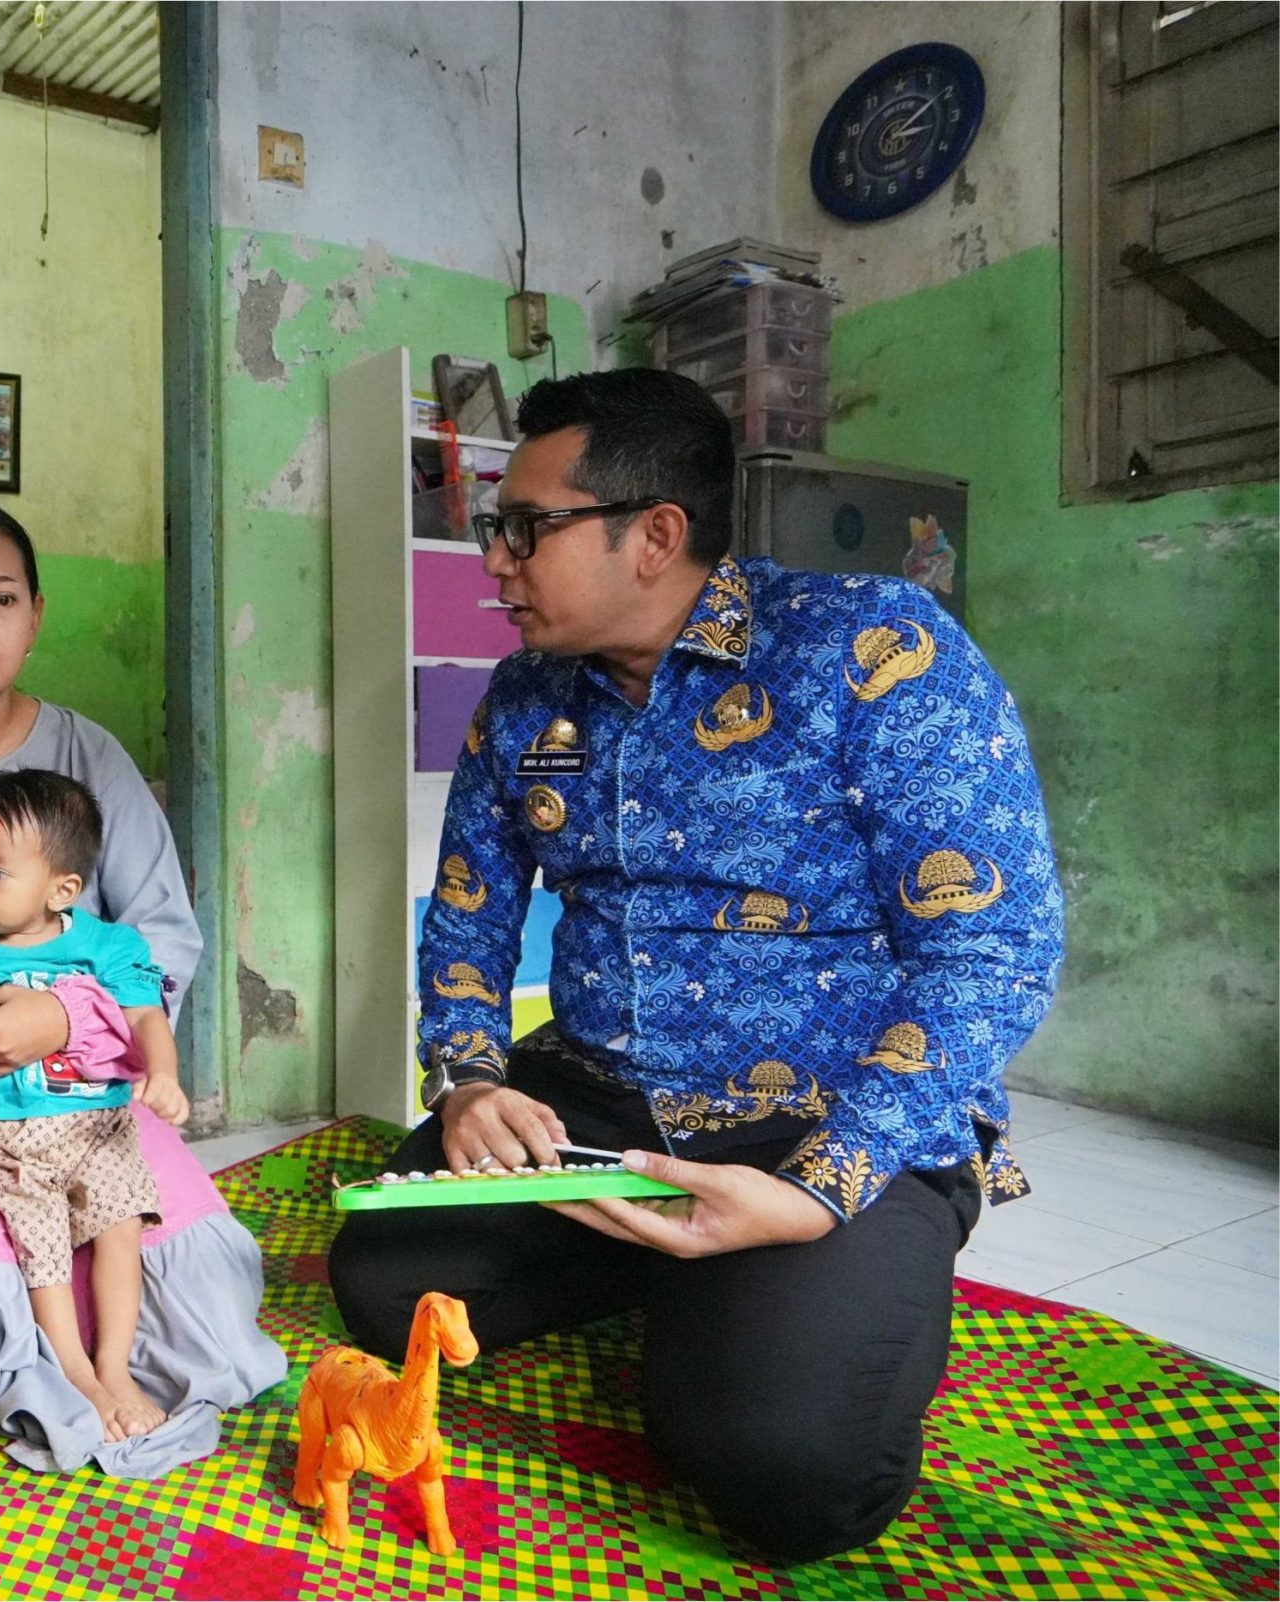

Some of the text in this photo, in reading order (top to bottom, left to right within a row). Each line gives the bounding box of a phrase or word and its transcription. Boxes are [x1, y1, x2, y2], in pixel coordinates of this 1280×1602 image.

[925, 73, 932, 85] 1
[944, 85, 954, 99] 2
[867, 95, 878, 109] 11
[950, 109, 960, 123] 3
[846, 122, 860, 136] 10
[938, 141, 948, 151] 4
[838, 151, 846, 164] 9
[916, 167, 925, 180] 5
[844, 174, 854, 186] 8
[864, 185, 871, 197] 7
[887, 182, 897, 194] 6
[539, 759, 549, 767] ALI
